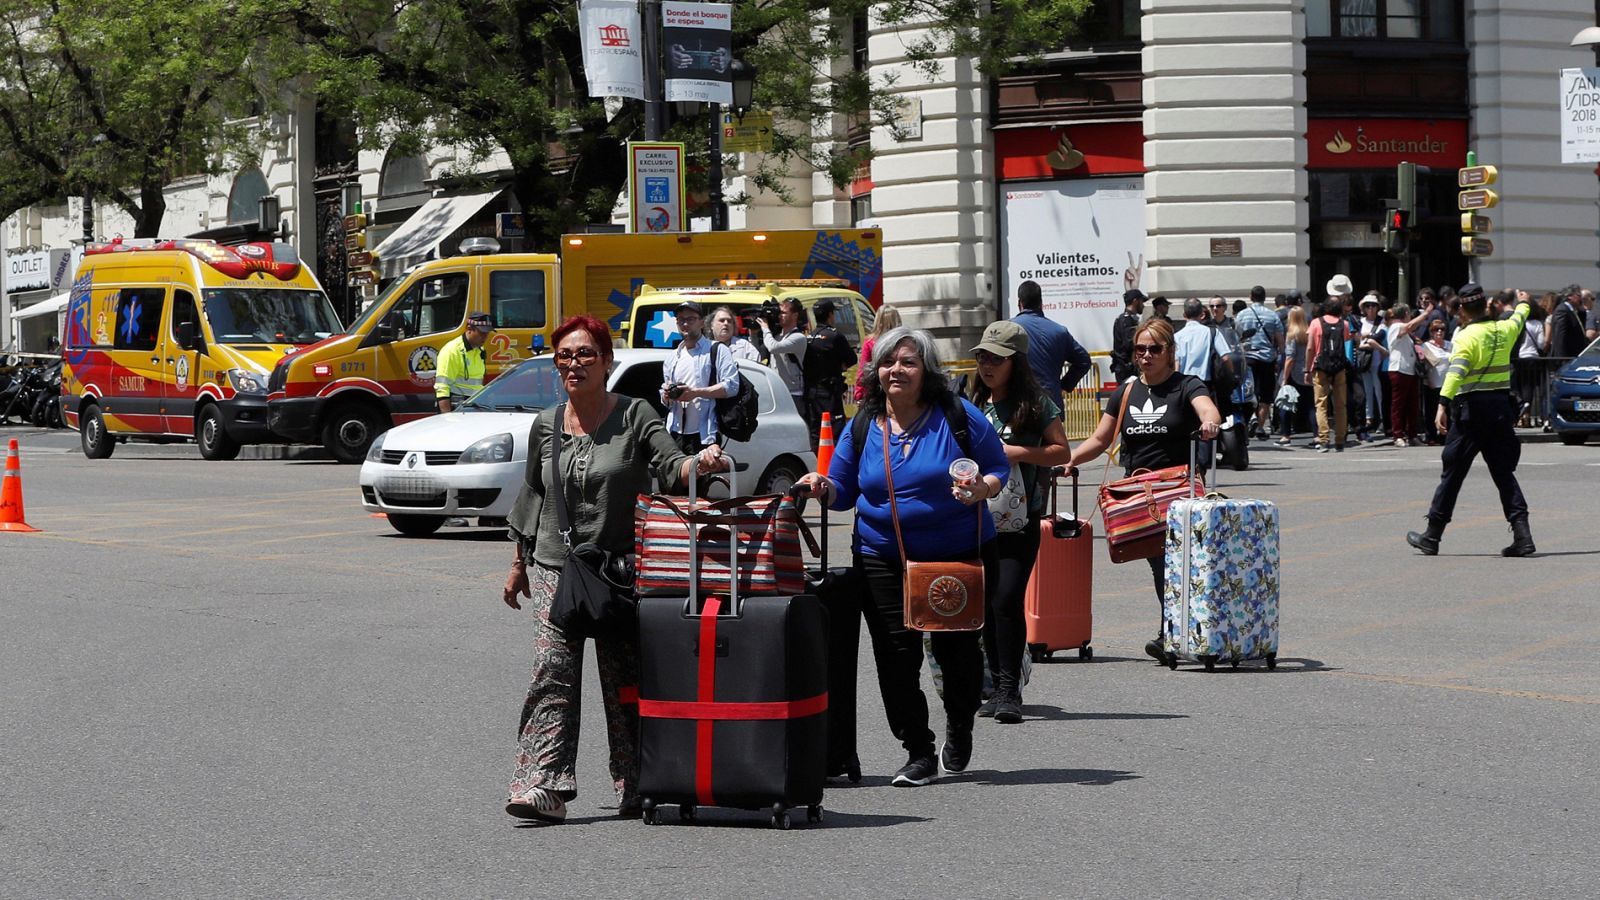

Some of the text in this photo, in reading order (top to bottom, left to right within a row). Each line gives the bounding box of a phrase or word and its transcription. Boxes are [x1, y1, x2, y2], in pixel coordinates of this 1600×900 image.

[666, 9, 728, 20] Donde el bosque
[1568, 77, 1597, 94] SAN
[1566, 93, 1600, 110] ISIDR
[1572, 110, 1597, 122] 2018
[1357, 134, 1448, 153] Santander
[241, 260, 279, 270] SAMUR
[1036, 252, 1100, 265] Valientes,
[12, 257, 43, 274] OUTLET
[53, 252, 71, 287] LONDRES
[1020, 265, 1119, 279] os necesitamos.
[1041, 302, 1057, 310] enta
[1075, 299, 1118, 309] Profesional
[341, 361, 366, 373] 8771
[119, 376, 145, 391] SAMUR
[1126, 424, 1168, 435] adidas
